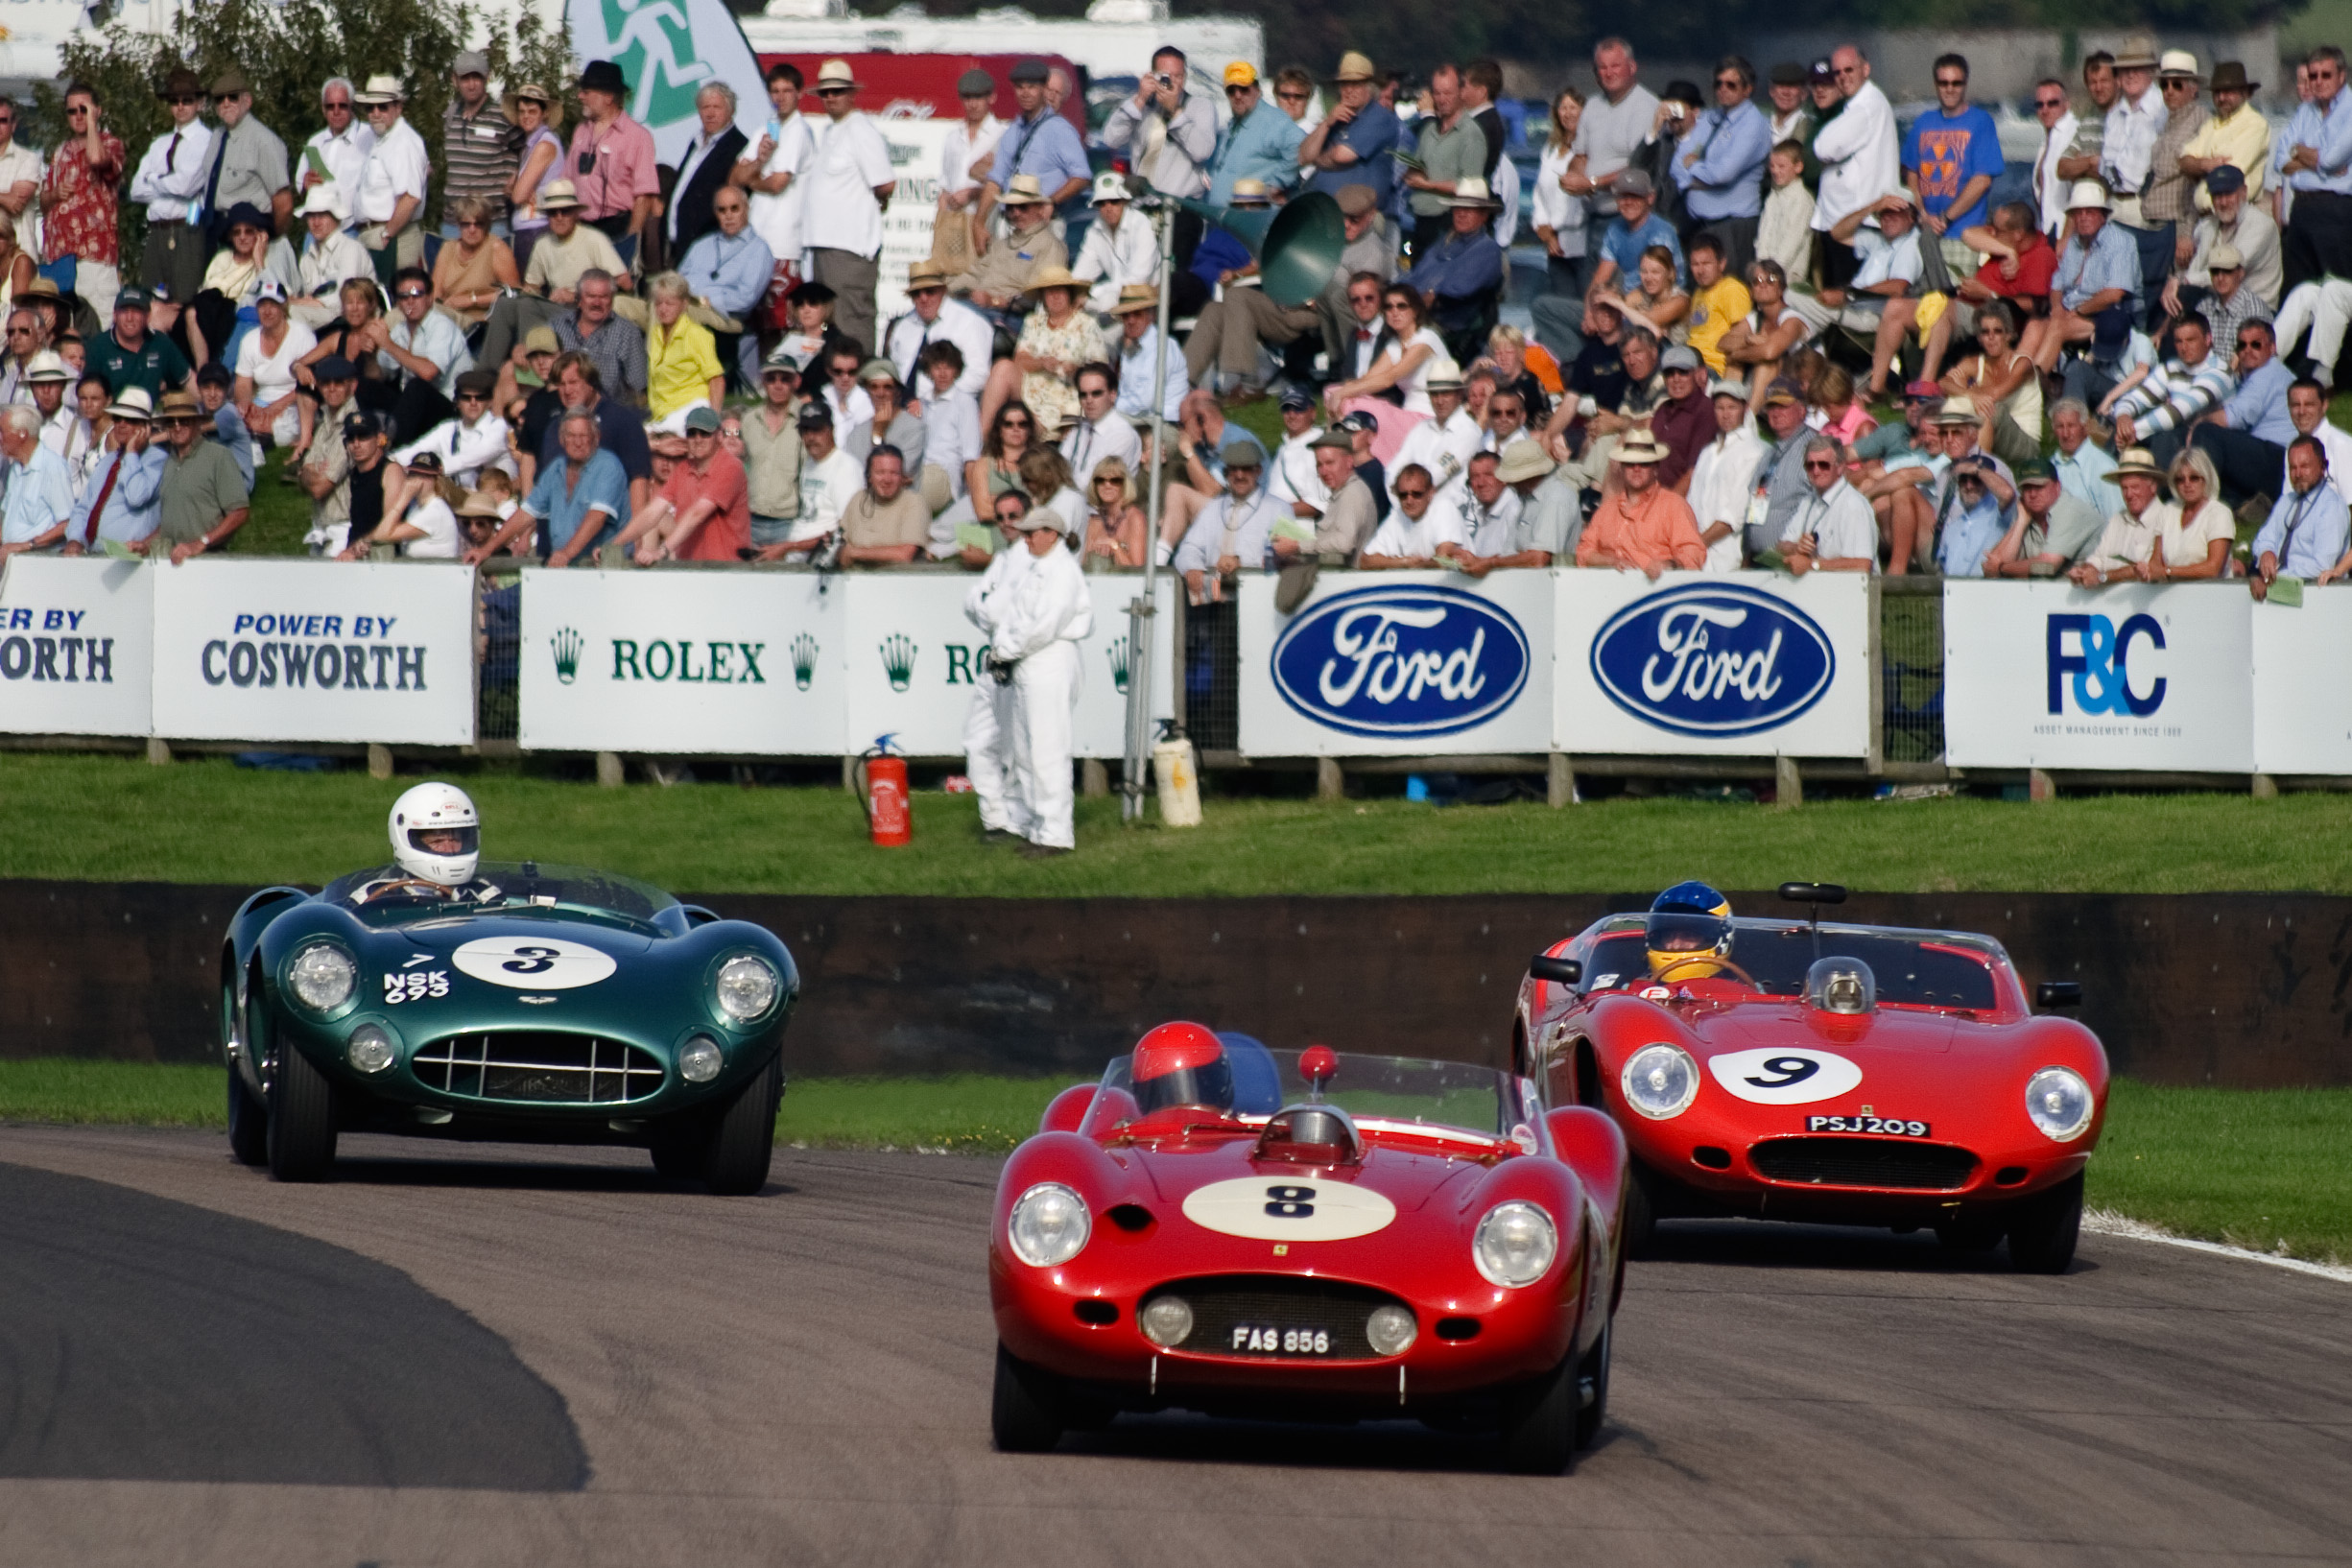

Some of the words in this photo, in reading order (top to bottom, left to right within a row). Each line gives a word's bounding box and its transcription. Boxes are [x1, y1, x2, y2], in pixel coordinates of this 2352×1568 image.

[43, 609, 86, 631] BY
[233, 613, 344, 638] POWER
[353, 616, 397, 639] BY
[0, 635, 114, 683] ORTH
[202, 639, 428, 691] COSWORTH
[611, 639, 766, 684] ROLEX
[1319, 606, 1485, 706] Ford
[1642, 605, 1783, 702] Ford
[2047, 612, 2168, 718] F&C
[2033, 725, 2062, 736] ASSET
[2066, 725, 2129, 736] MANAGEMENT
[2133, 726, 2159, 737] SINCE
[502, 946, 560, 974] 3
[384, 970, 447, 990] NSK
[385, 982, 449, 1005] 693
[1743, 1057, 1820, 1088] 9
[1265, 1185, 1317, 1219] 8
[1232, 1327, 1278, 1351] FAS
[1284, 1330, 1328, 1353] 856
